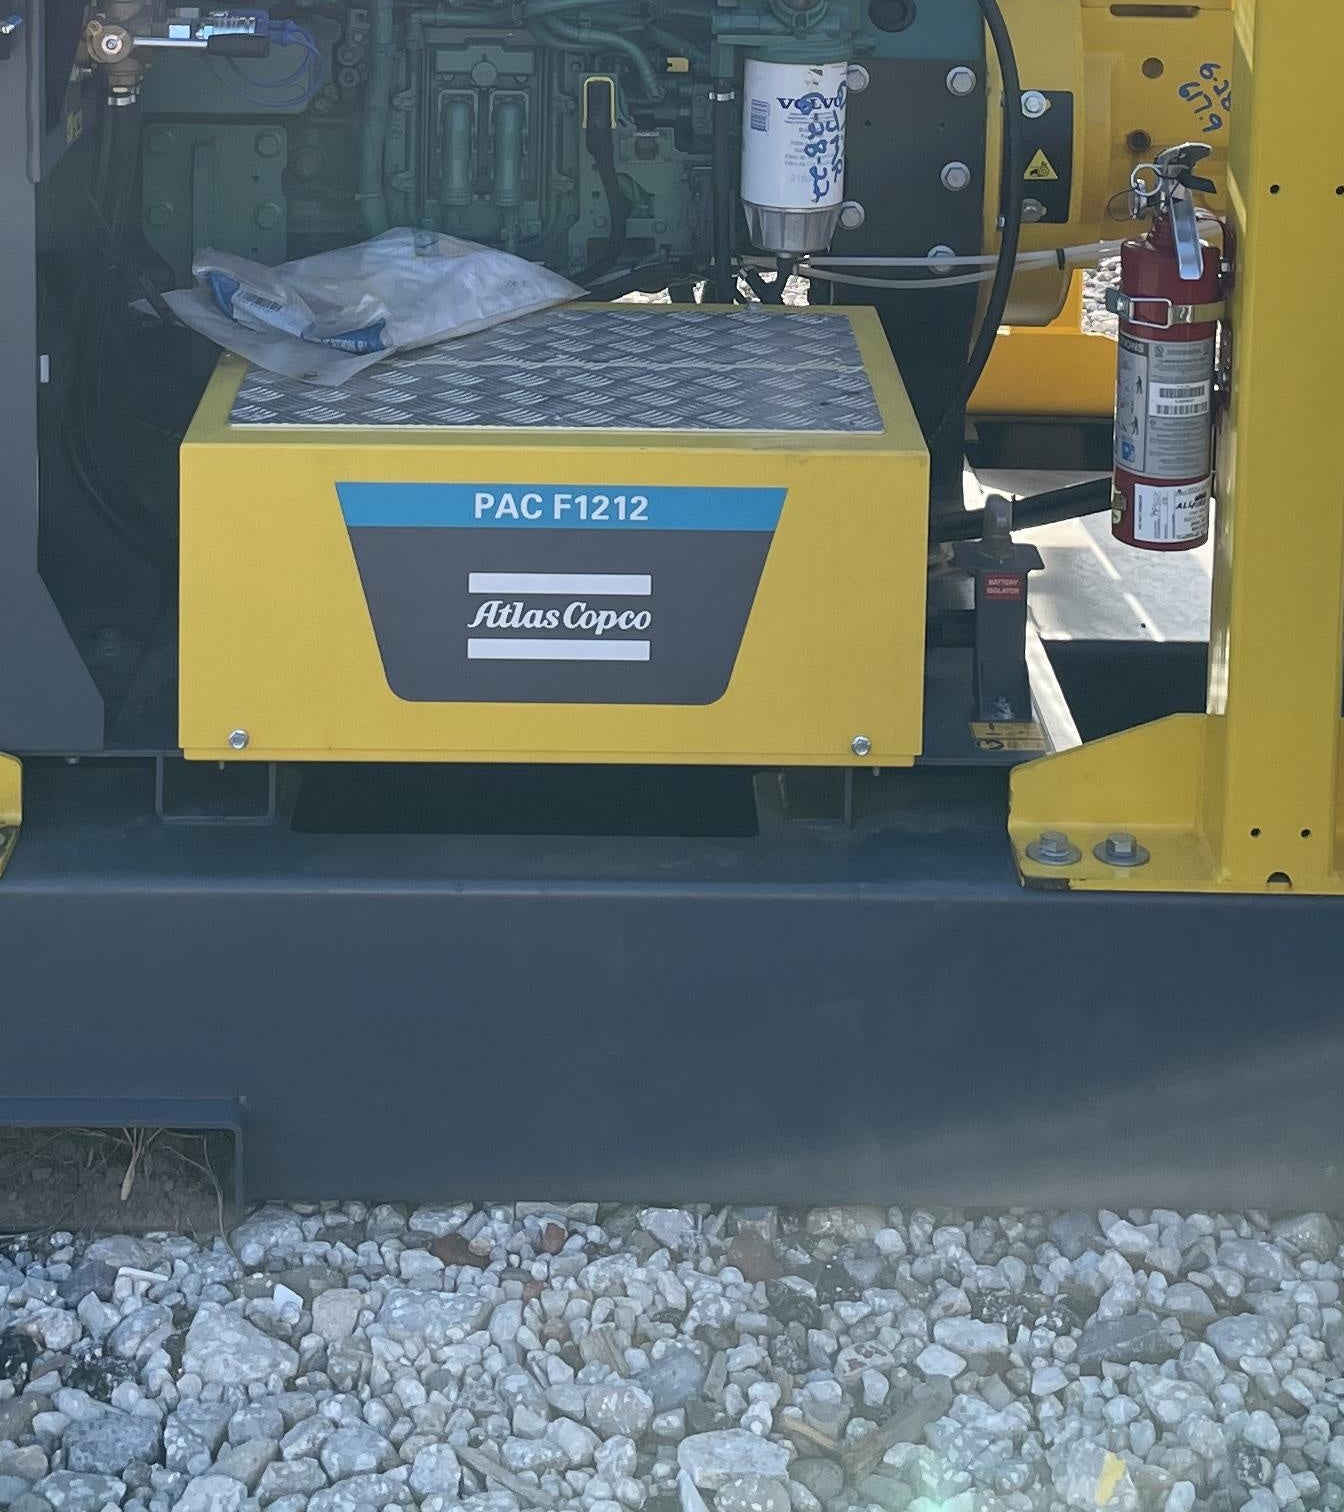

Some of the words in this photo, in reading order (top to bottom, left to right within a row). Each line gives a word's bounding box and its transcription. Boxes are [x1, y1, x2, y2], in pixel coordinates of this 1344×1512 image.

[474, 492, 544, 520] PAC
[553, 493, 650, 522] F1212
[467, 599, 559, 631] Atlas
[562, 601, 652, 636] Copco
